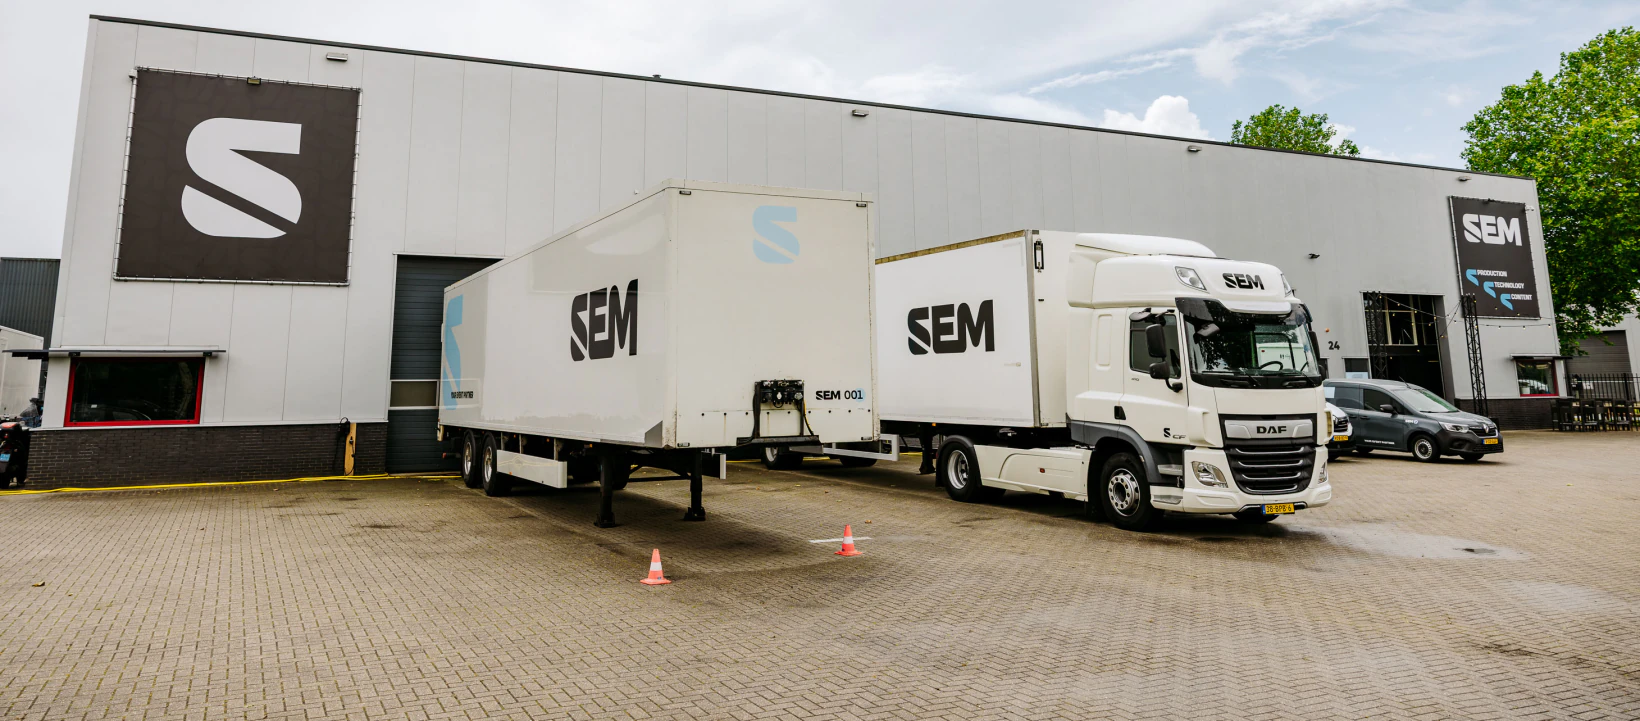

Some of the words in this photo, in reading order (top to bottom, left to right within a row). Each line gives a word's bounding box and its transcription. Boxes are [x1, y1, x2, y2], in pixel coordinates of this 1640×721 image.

[182, 117, 302, 239] S
[752, 205, 800, 264] S
[1462, 213, 1523, 247] SEM
[1476, 269, 1508, 277] PRODUCTION
[1223, 273, 1264, 290] SEM
[1493, 281, 1525, 289] TECHNOLOGY
[1510, 293, 1533, 301] CONTENT
[570, 278, 639, 362] SEM
[907, 299, 995, 355] SEM
[1327, 340, 1341, 351] 24
[815, 390, 841, 400] SEM
[844, 390, 864, 400] 001
[1256, 425, 1287, 434] DAF
